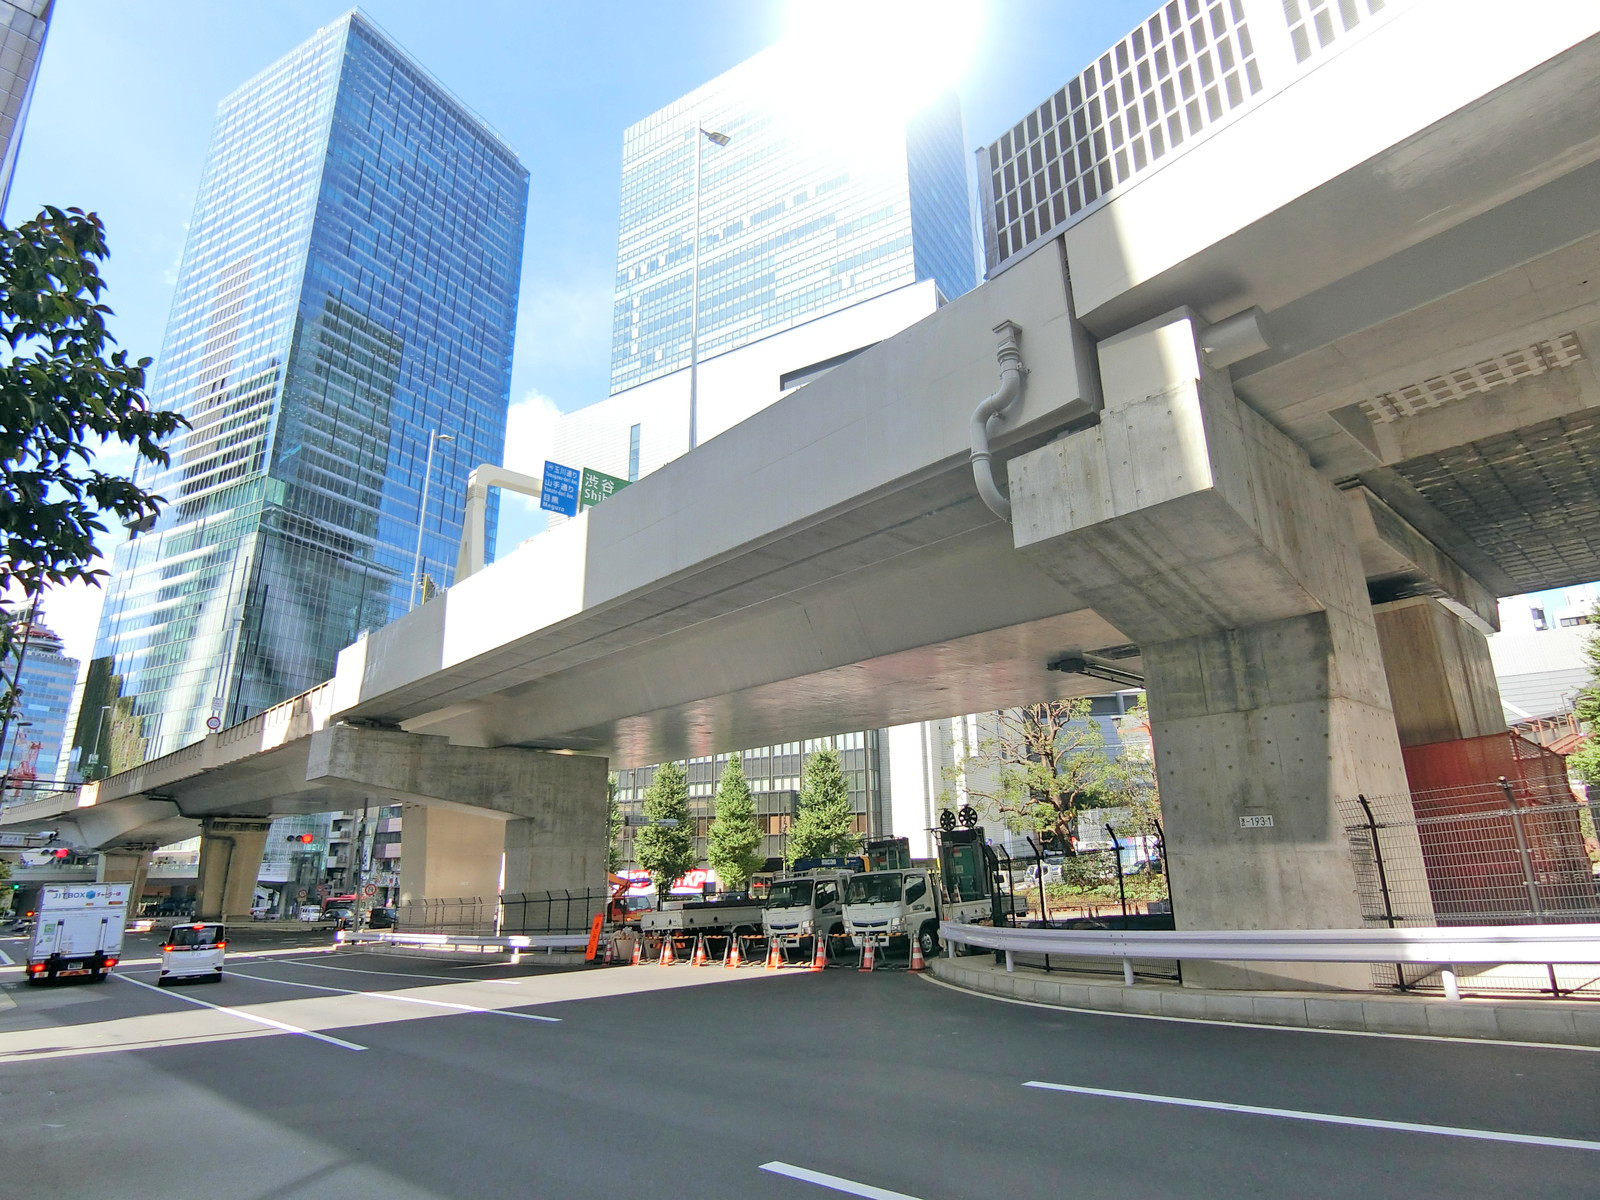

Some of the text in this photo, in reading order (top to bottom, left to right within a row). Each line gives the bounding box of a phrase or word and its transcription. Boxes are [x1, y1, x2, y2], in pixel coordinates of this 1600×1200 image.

[553, 465, 578, 479] 玉川通り
[544, 479, 574, 493] 山手通り
[585, 473, 615, 494] 渋谷
[543, 493, 559, 504] 目黒
[542, 501, 565, 512] Meguro
